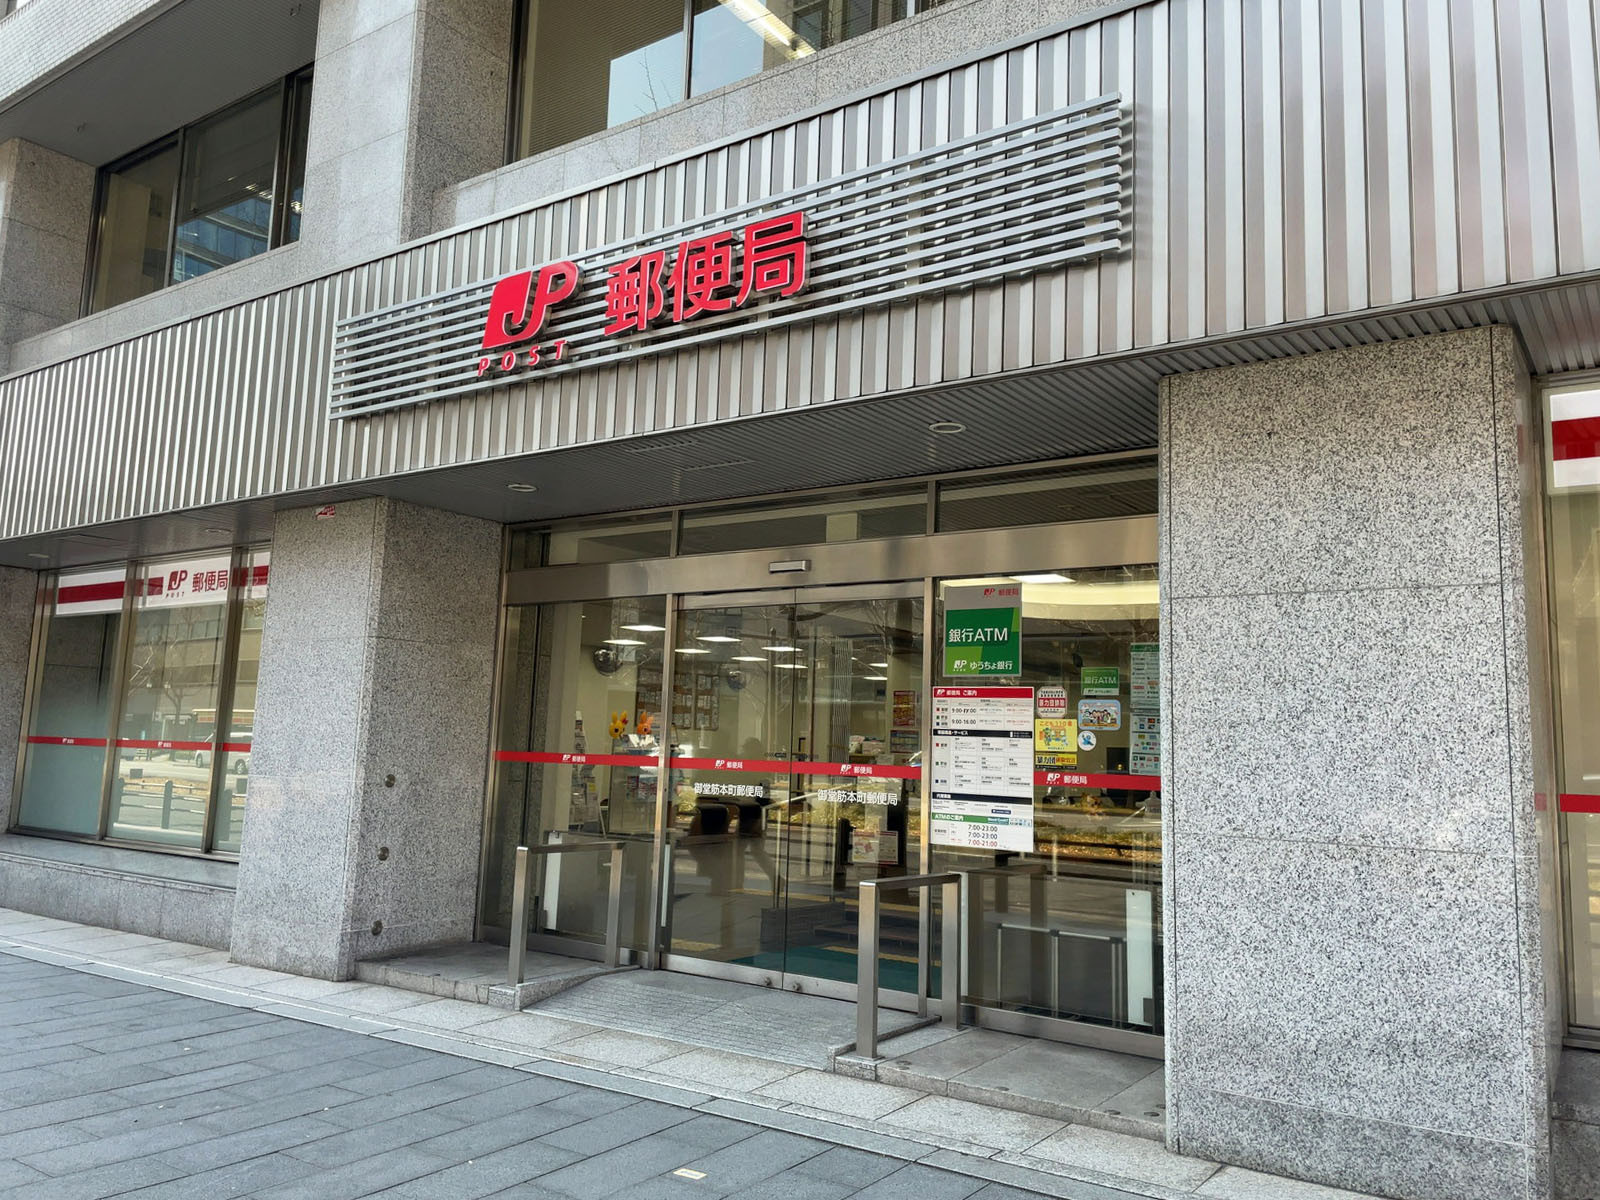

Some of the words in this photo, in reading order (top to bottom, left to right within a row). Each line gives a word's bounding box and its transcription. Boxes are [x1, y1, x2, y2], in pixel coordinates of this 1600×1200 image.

[604, 211, 807, 336] 郵便局
[478, 340, 566, 376] POST
[192, 569, 228, 593] 郵便局
[949, 627, 1008, 643] 銀行ATM
[970, 660, 1013, 671] ゆうちょ銀行
[726, 761, 743, 769] 郵便局
[853, 766, 873, 774] 郵便局
[1063, 775, 1088, 784] 郵便局
[694, 782, 764, 799] 御堂筋本町郵便局
[817, 789, 898, 807] 御堂筋本町郵便局
[968, 824, 998, 832] 7:00-23:00
[968, 832, 998, 840] 7:00-23:00
[968, 839, 998, 847] 7:00-21:00
